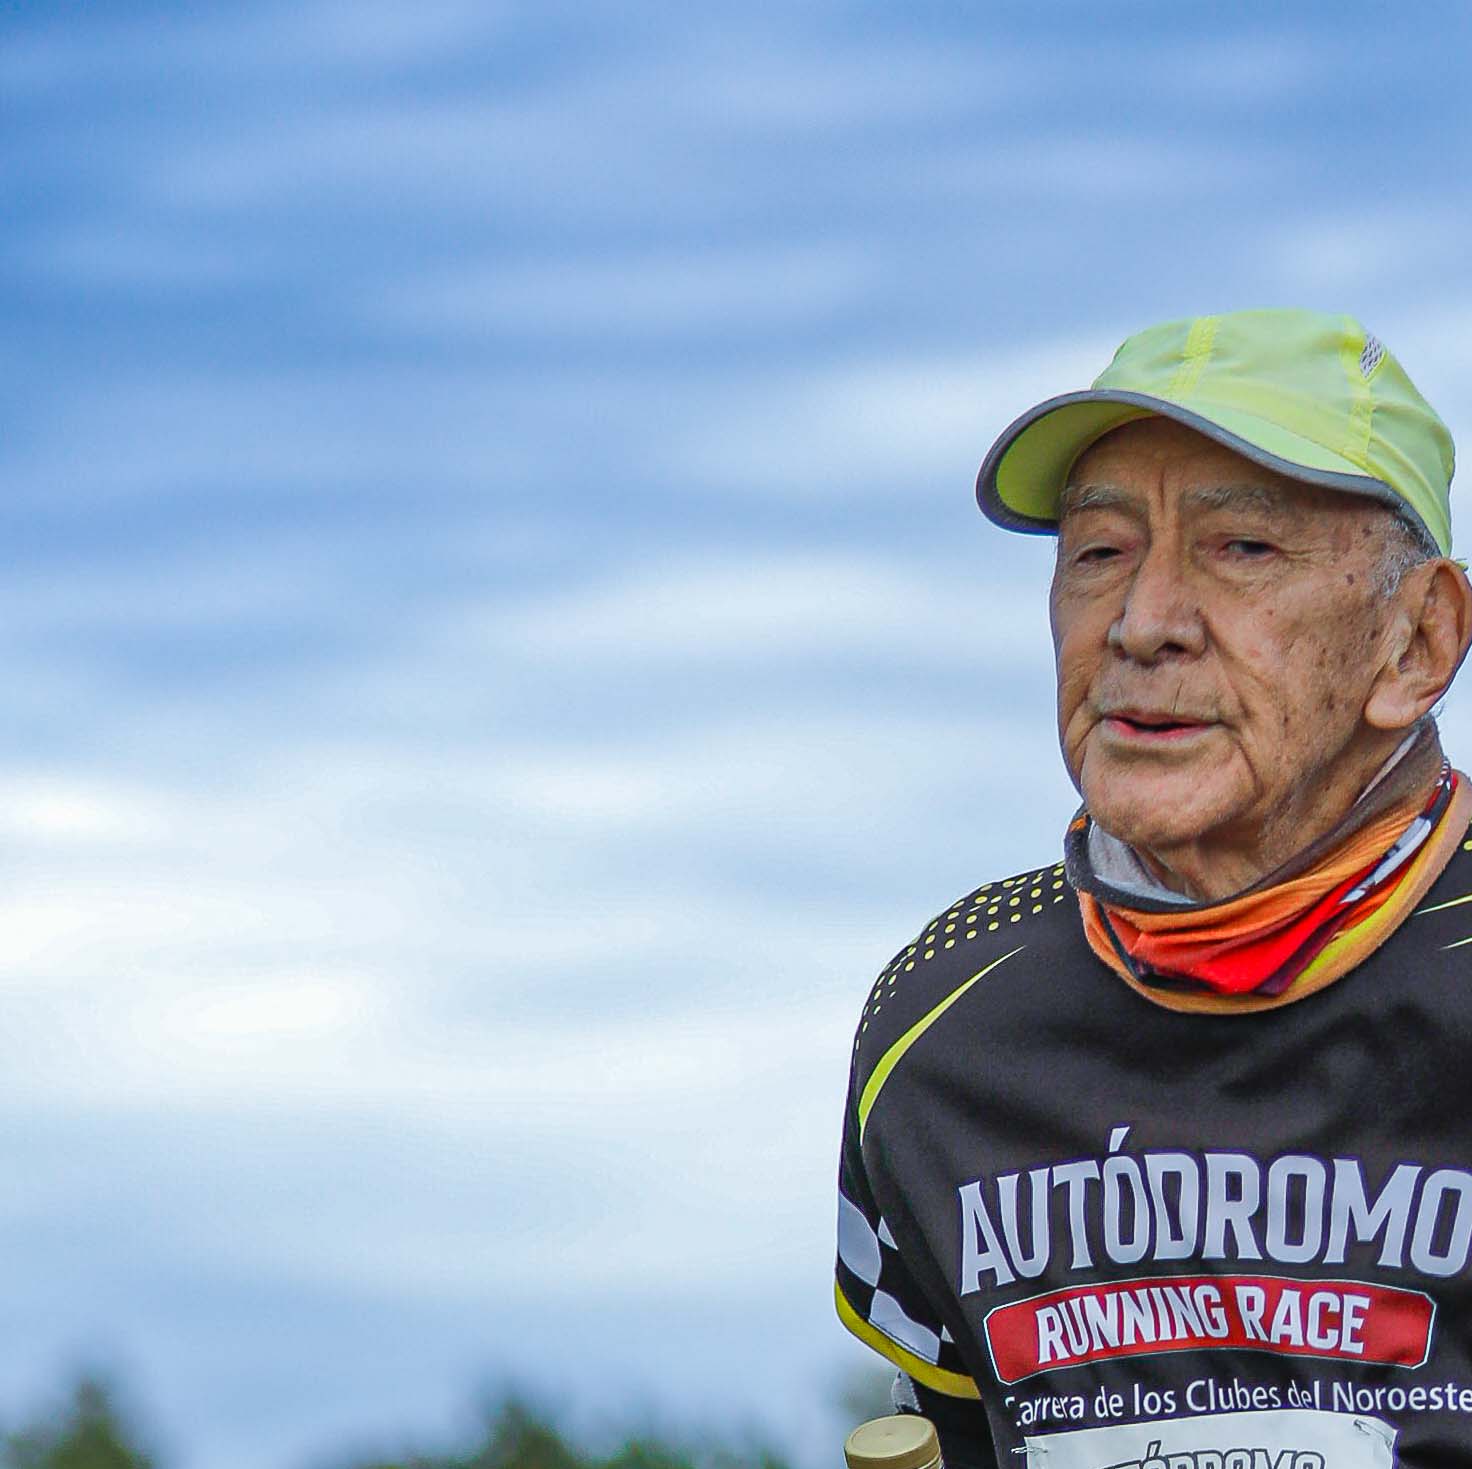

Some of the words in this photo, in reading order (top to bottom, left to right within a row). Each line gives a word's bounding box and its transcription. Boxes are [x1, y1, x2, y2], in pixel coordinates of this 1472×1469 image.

[1035, 1285, 1228, 1366] RUNNING
[1234, 1285, 1372, 1354] RACE
[1094, 1385, 1124, 1418] de
[1134, 1383, 1176, 1416] los
[1186, 1378, 1282, 1412] Clubes
[1287, 1379, 1320, 1411] del
